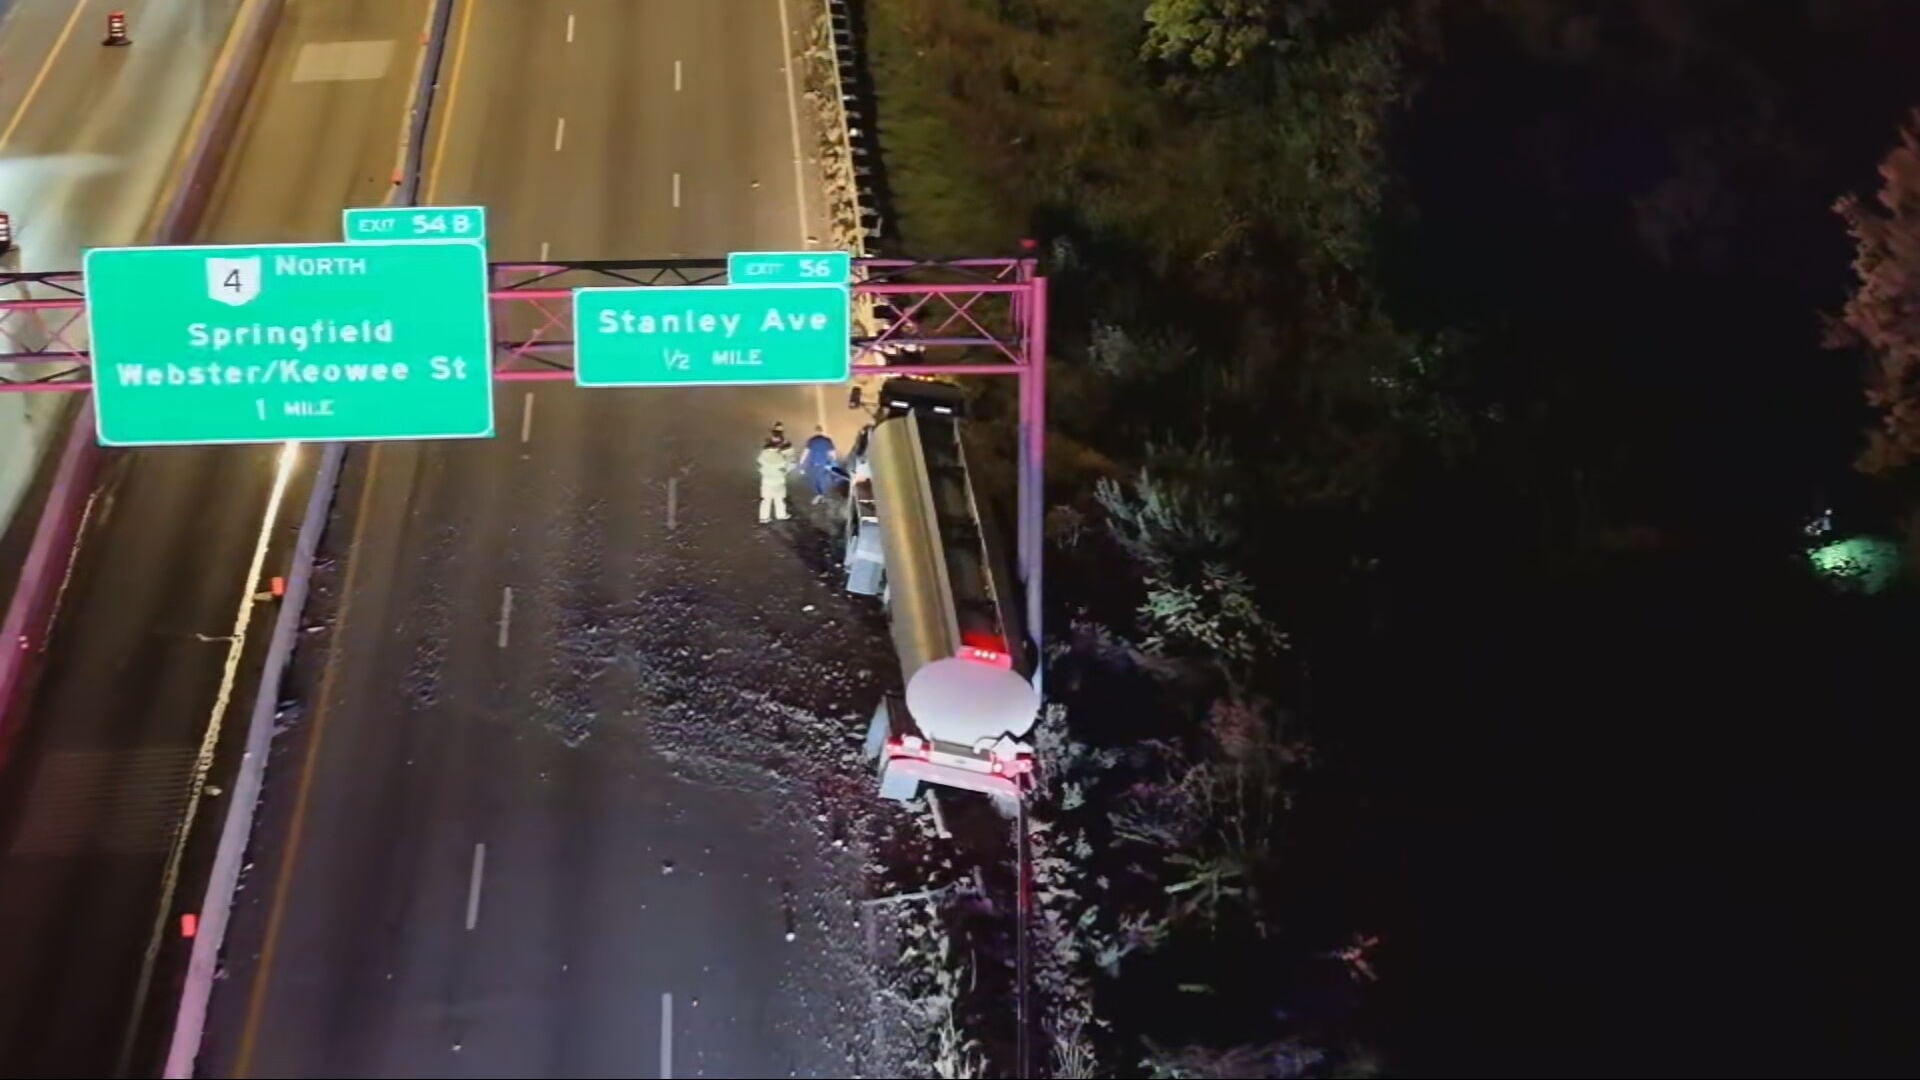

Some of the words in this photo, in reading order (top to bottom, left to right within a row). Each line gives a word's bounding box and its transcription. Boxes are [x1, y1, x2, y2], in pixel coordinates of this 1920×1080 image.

[275, 256, 366, 277] NORTH
[799, 259, 831, 278] 56
[222, 268, 243, 293] 4
[187, 319, 393, 350] Springfield
[598, 308, 742, 338] Stanley
[760, 308, 829, 332] Ave
[711, 349, 763, 366] MILE
[116, 357, 410, 388] Webster/Keowee
[430, 356, 468, 381] St
[255, 398, 267, 421] 1
[283, 398, 335, 417] MILE
